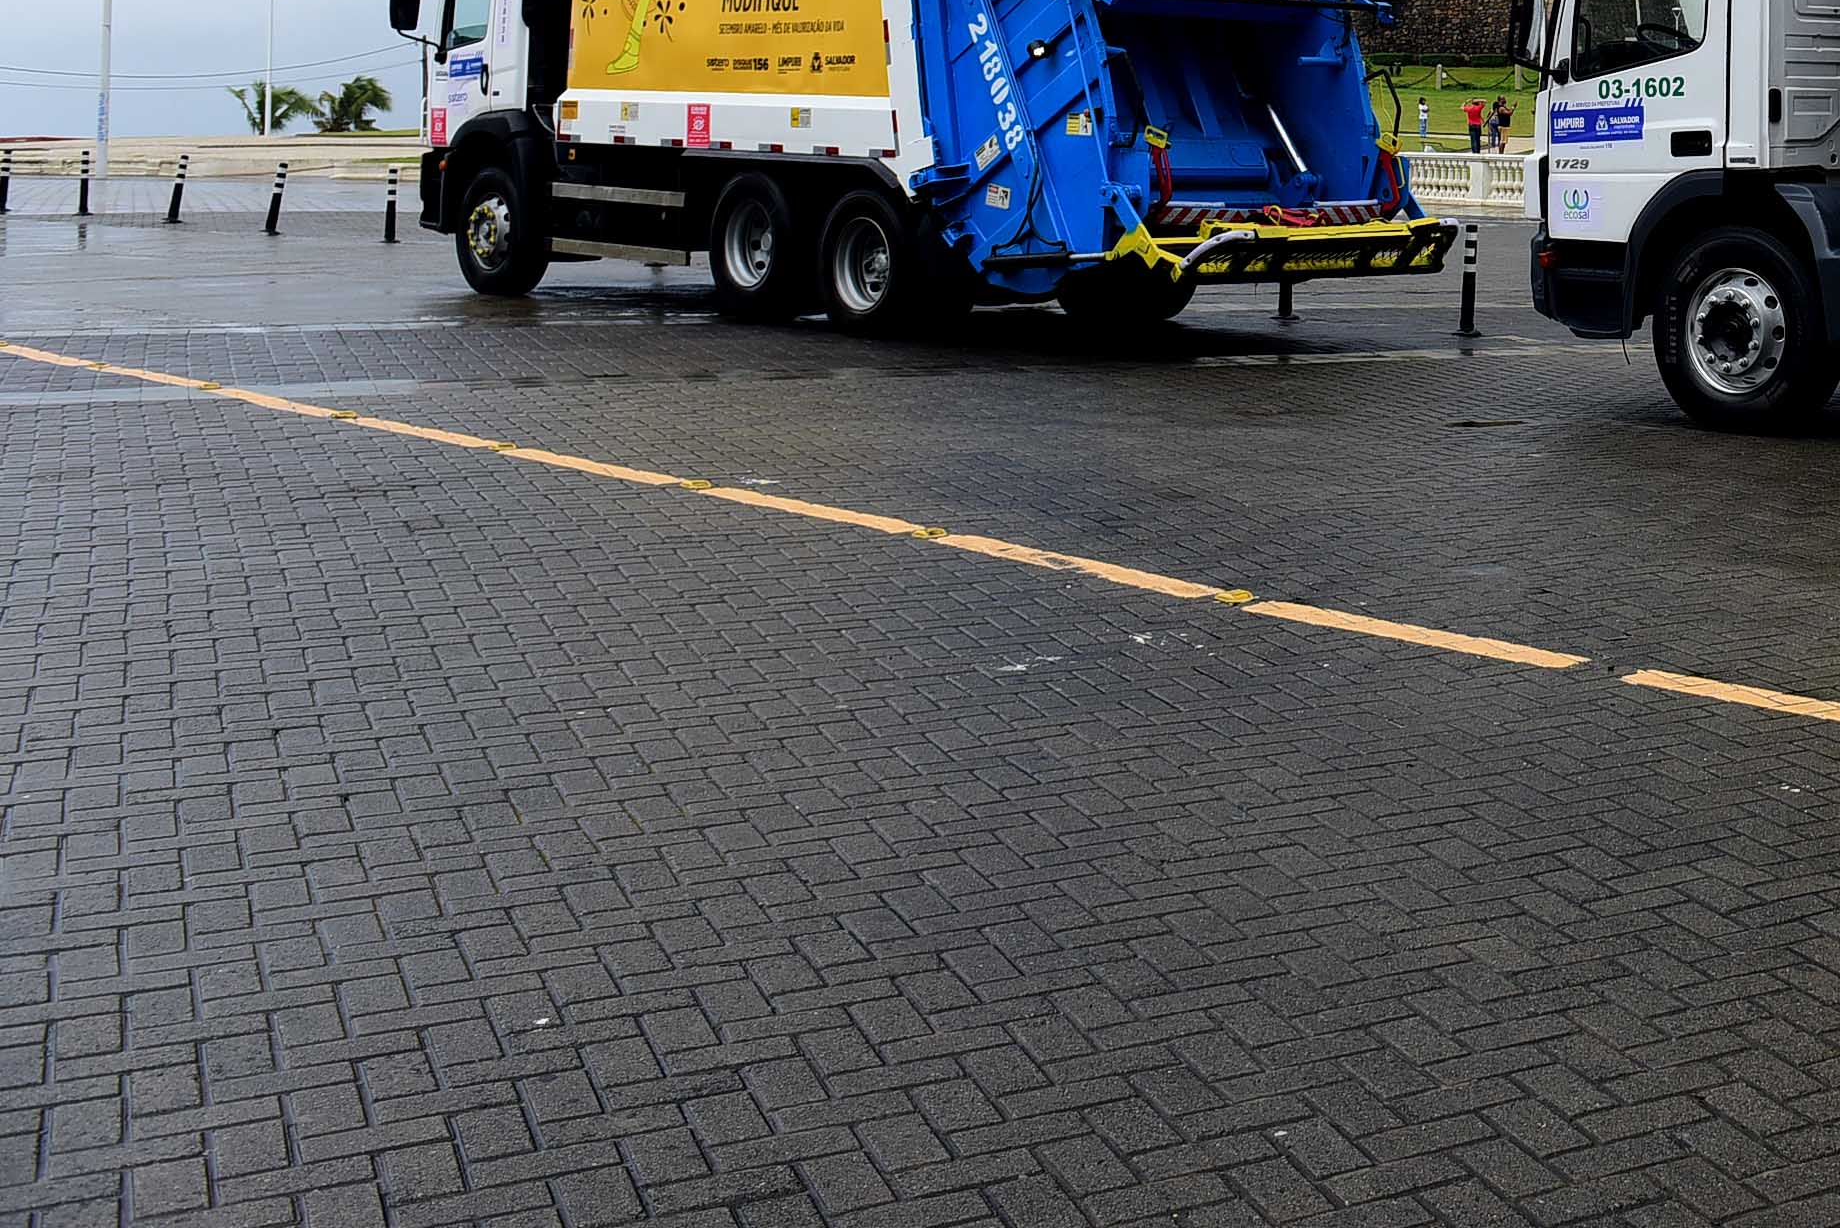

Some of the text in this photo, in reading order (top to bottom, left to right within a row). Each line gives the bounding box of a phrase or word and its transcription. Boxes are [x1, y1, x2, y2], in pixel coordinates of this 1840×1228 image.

[753, 57, 769, 71] 156
[824, 54, 856, 66] SALVADOR
[967, 12, 1025, 151] 218038
[1598, 76, 1685, 100] 03-1602
[1553, 116, 1585, 130] LIMPURB
[1609, 115, 1640, 125] SALVADOR
[1554, 158, 1590, 170] 1729
[1563, 209, 1590, 220] ecosal
